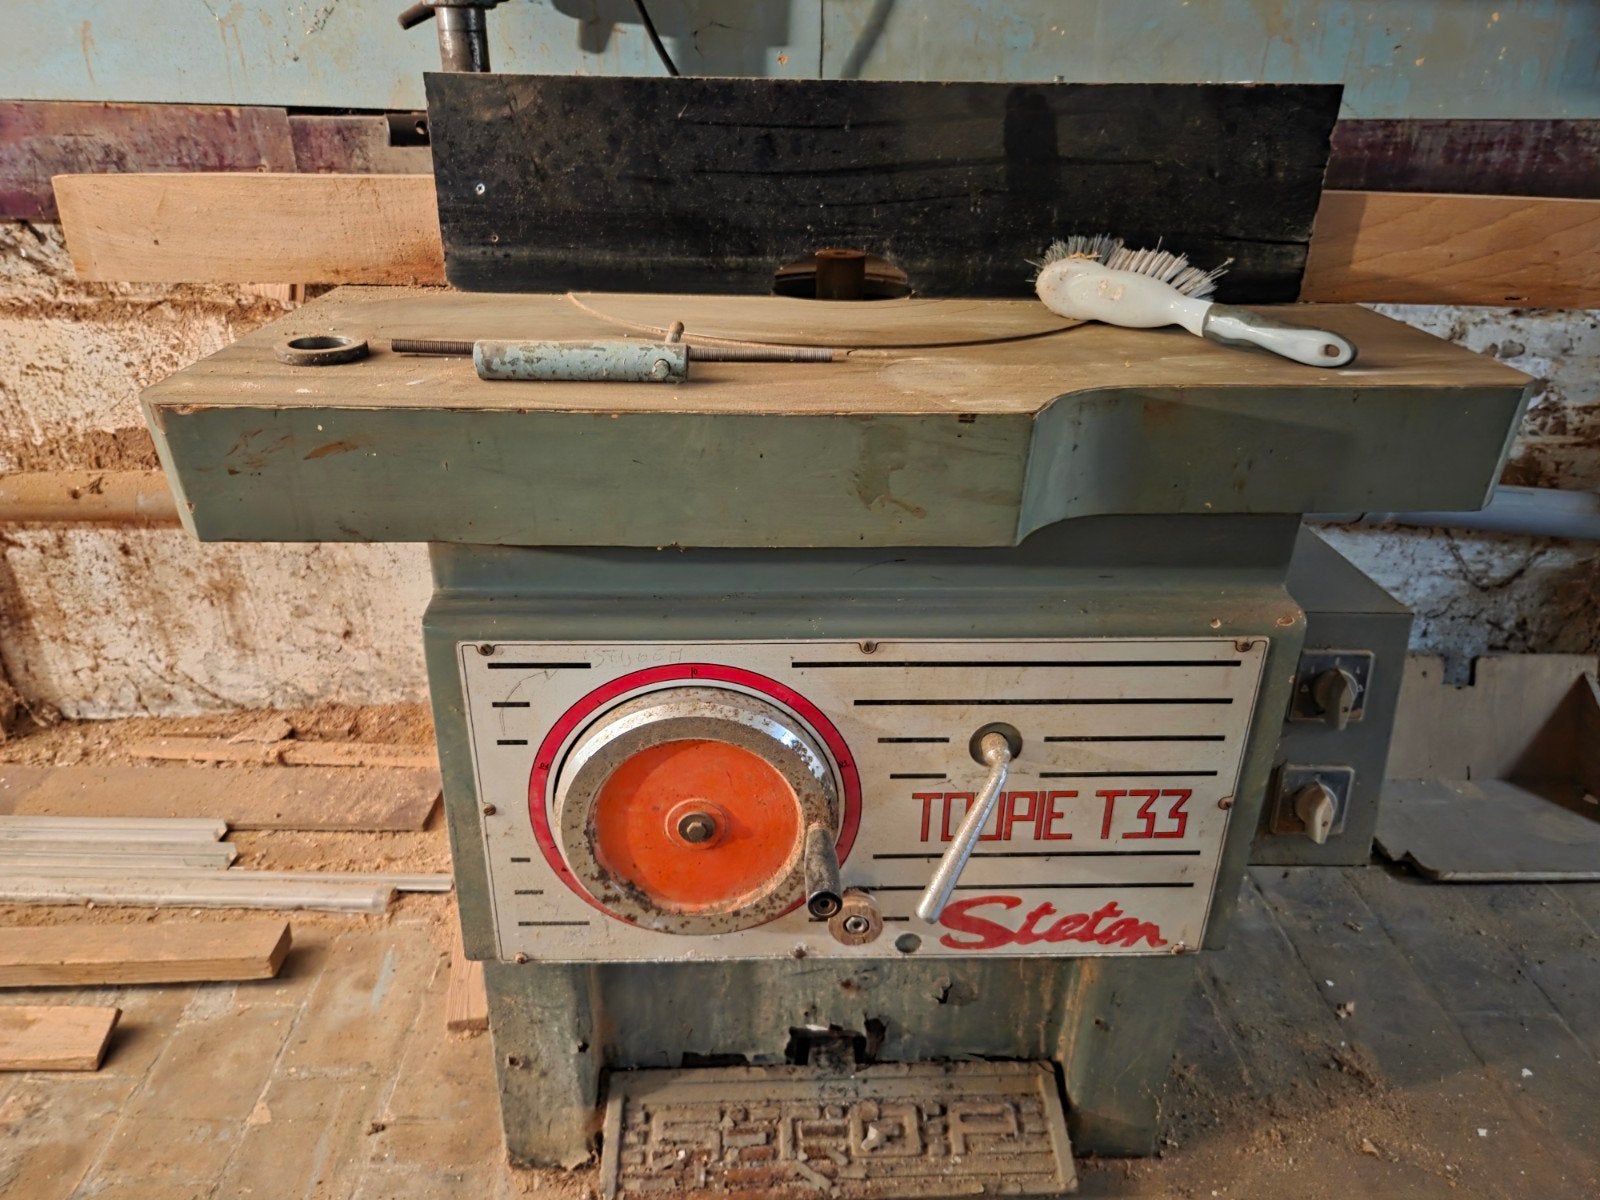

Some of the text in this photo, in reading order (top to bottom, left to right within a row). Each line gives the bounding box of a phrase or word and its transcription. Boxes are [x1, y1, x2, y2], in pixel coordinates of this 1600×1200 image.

[911, 788, 1193, 842] TOUPIE T33
[939, 895, 1168, 950] Steton
